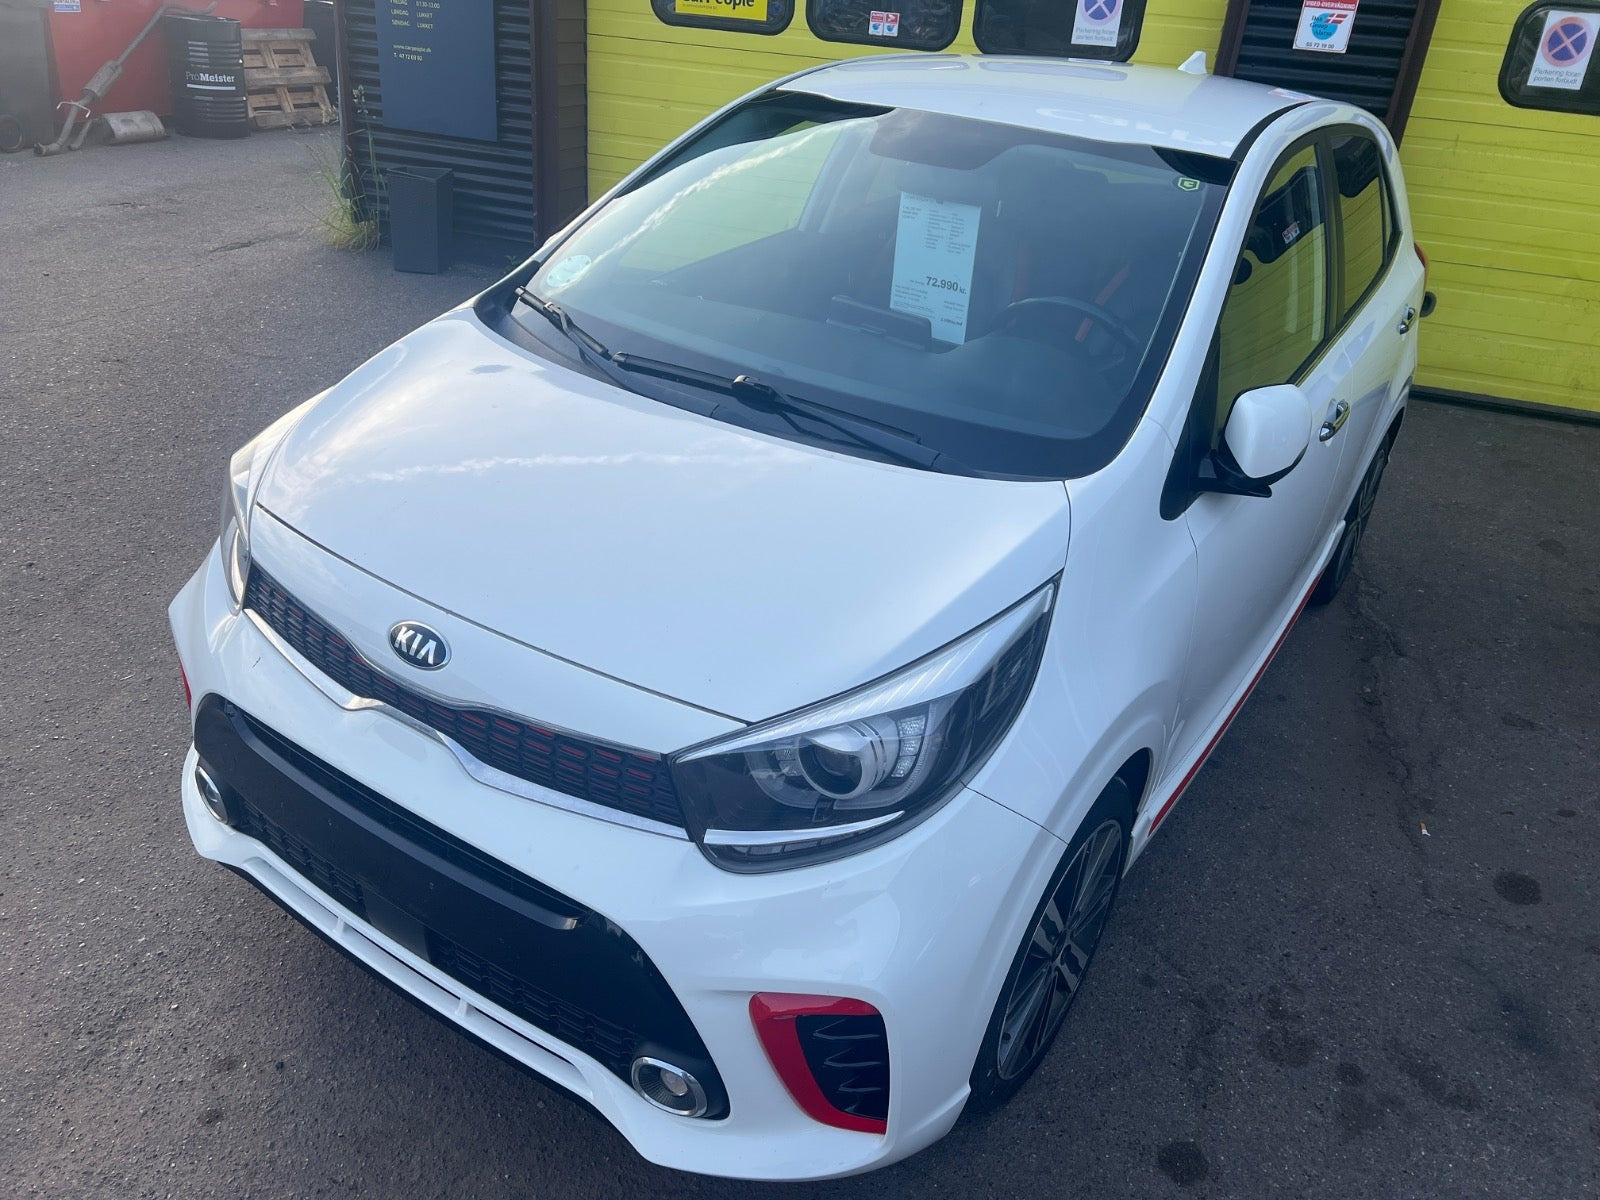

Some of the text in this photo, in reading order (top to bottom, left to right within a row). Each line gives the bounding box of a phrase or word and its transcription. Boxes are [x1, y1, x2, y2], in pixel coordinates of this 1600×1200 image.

[185, 71, 236, 83] ProMeister
[926, 275, 959, 292] 72.990
[394, 626, 437, 665] KIA
